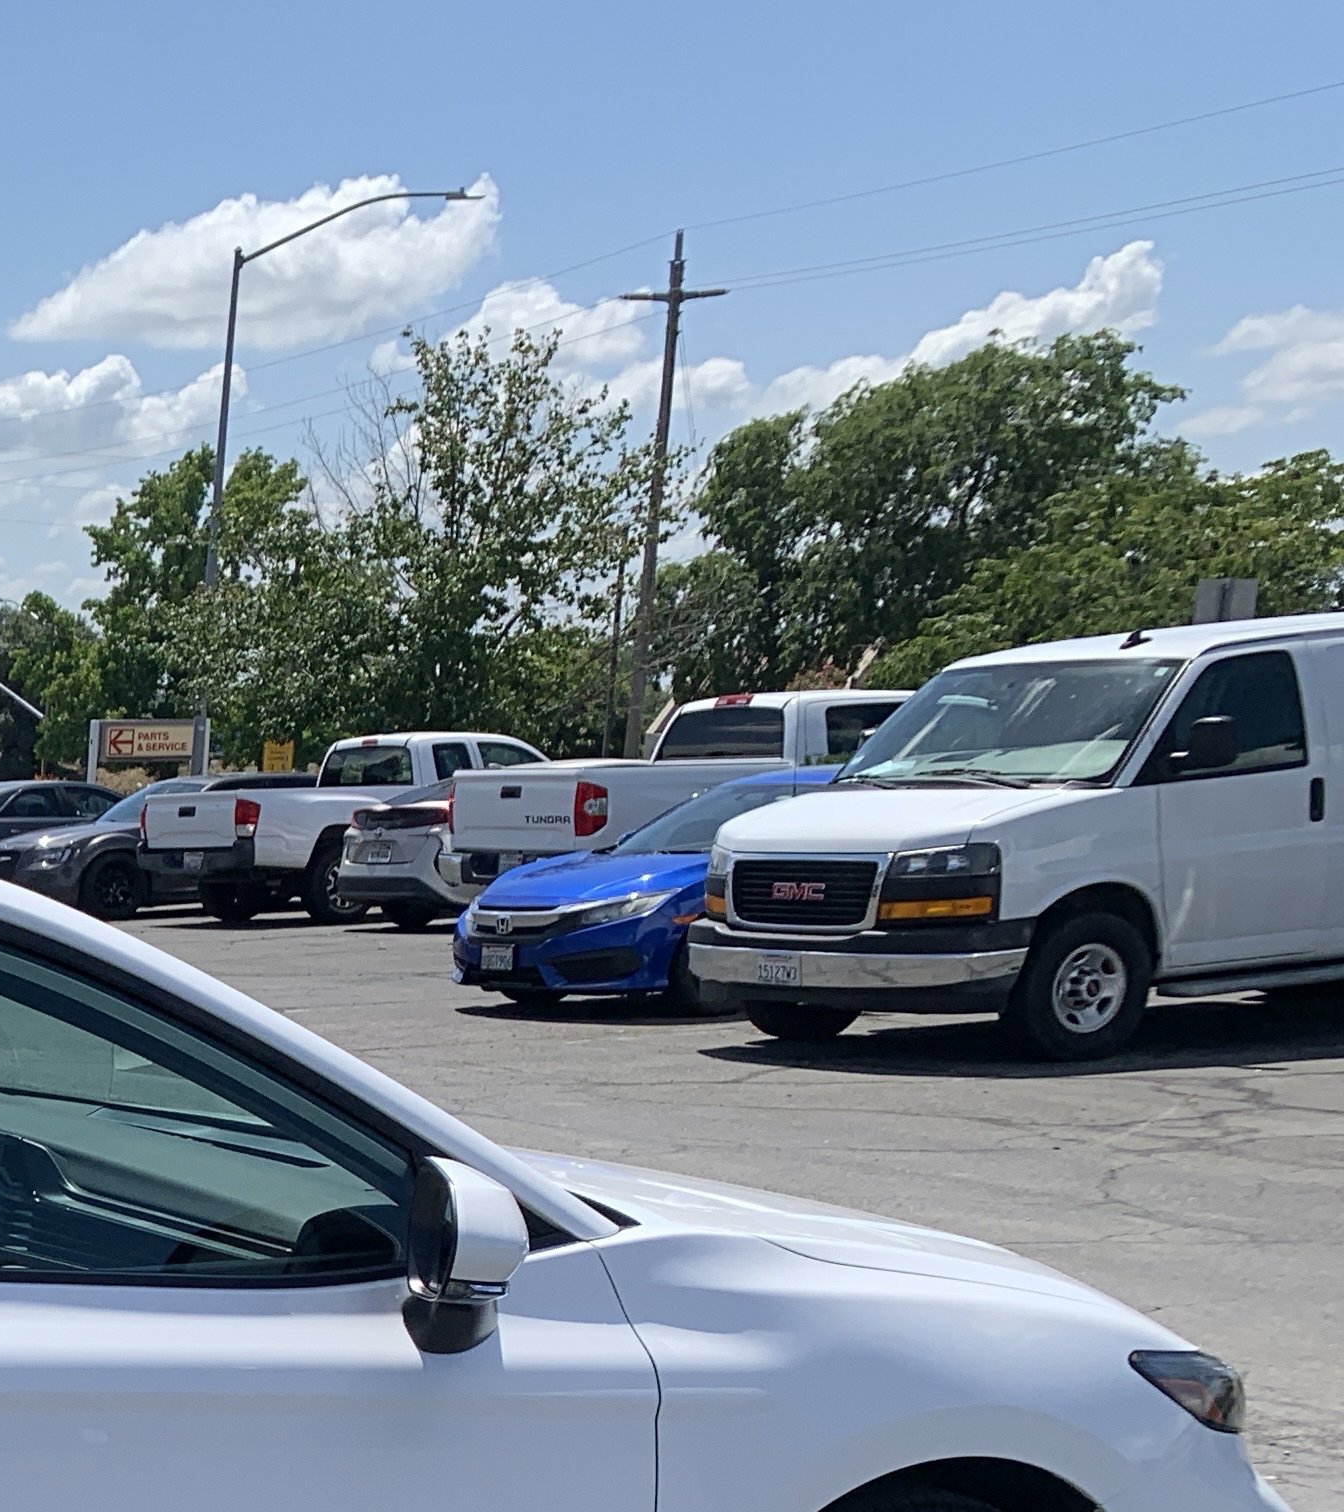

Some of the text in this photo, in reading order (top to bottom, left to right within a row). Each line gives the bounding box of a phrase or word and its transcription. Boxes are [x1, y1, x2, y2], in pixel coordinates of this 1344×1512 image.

[137, 731, 170, 742] PARTS
[137, 742, 188, 752] & SERVICE
[524, 814, 572, 825] TUNDRA
[772, 882, 826, 901] GMC
